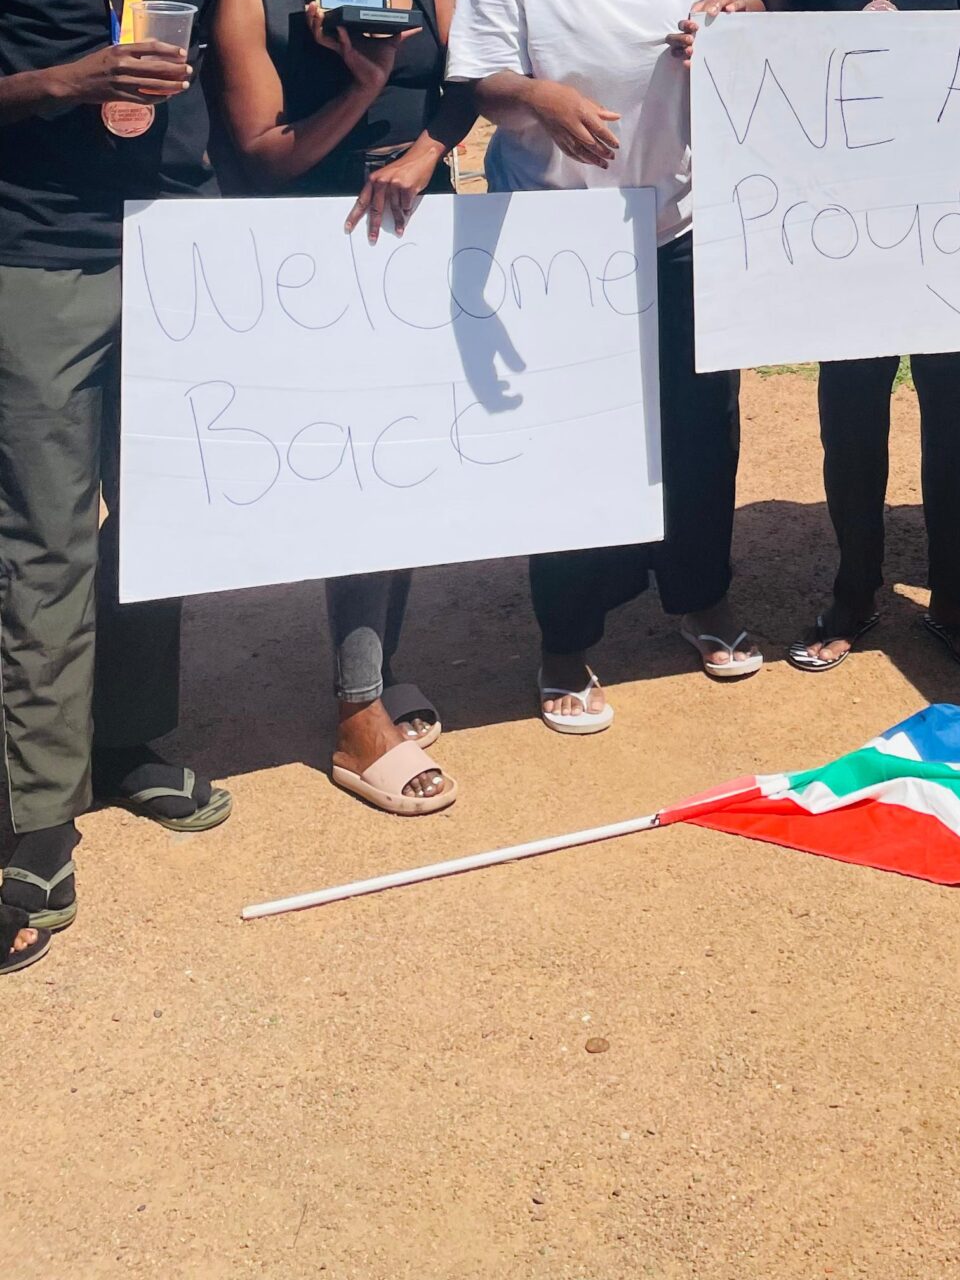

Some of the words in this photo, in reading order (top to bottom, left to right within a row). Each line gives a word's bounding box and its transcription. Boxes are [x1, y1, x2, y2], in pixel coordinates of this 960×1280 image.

[703, 48, 894, 149] WE
[138, 224, 655, 342] Welcome
[184, 380, 524, 506] Back
